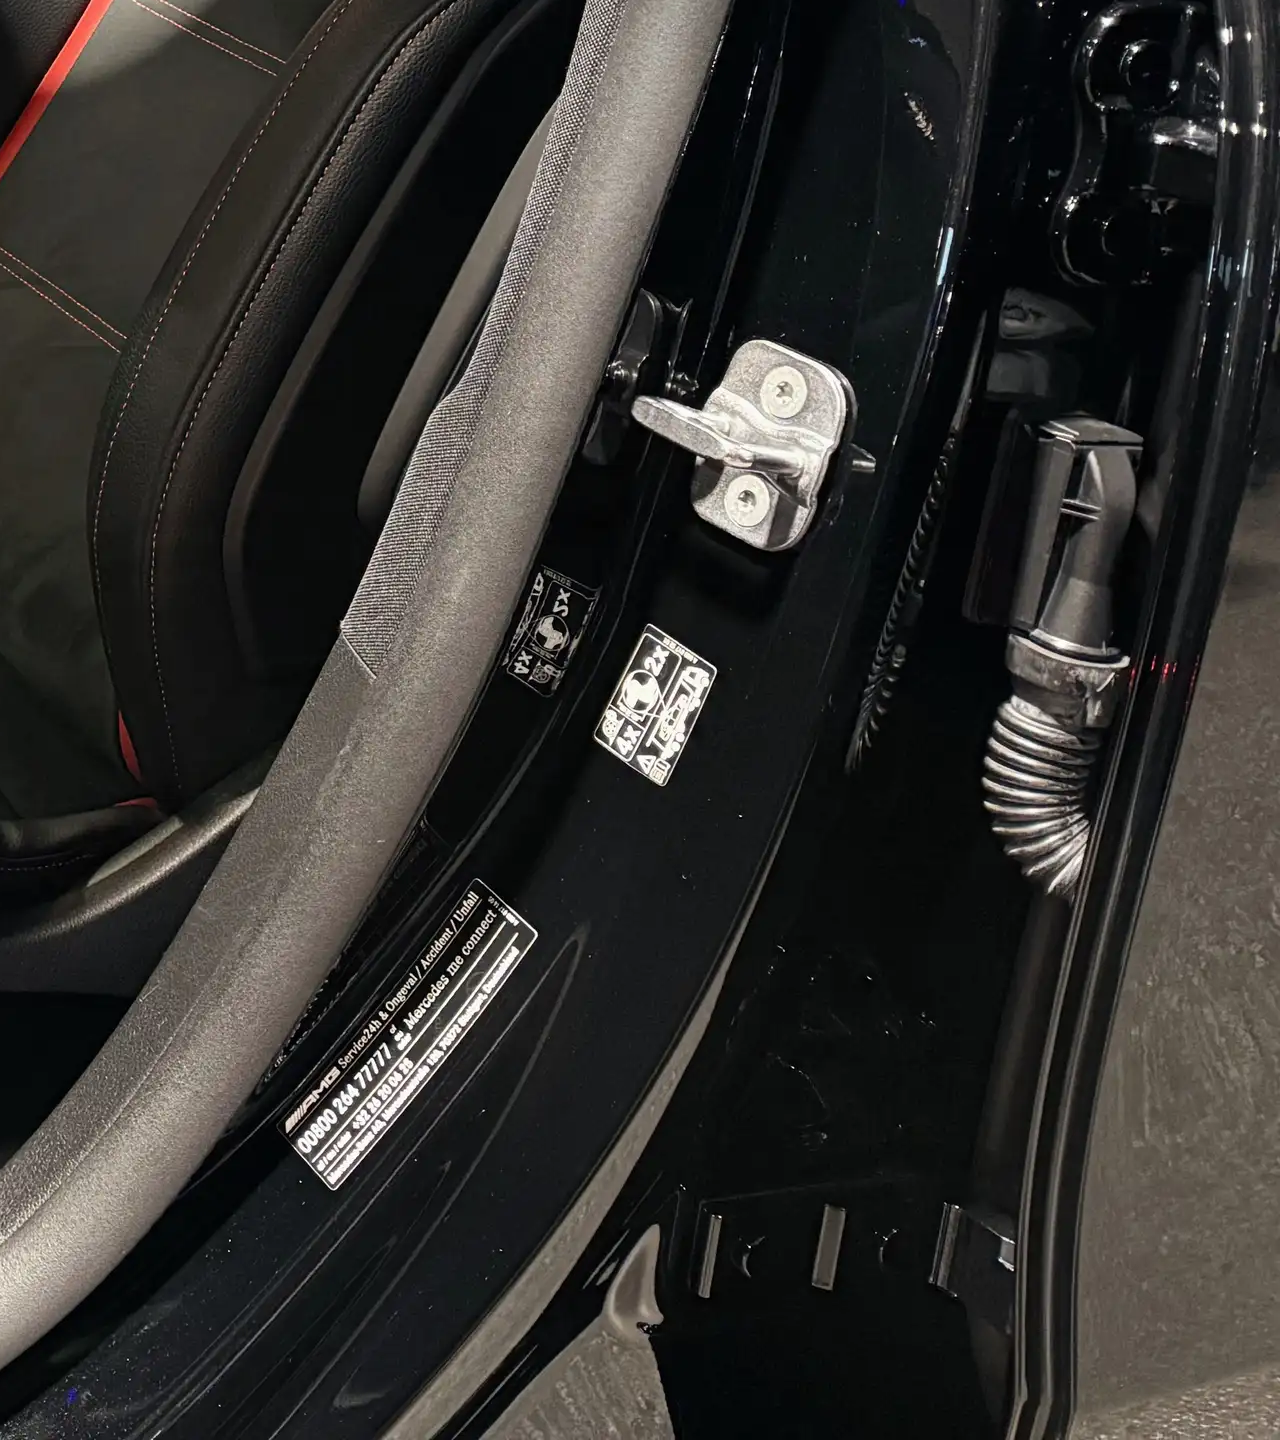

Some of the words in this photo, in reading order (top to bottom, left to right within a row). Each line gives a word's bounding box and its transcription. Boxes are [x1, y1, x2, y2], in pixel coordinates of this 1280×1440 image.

[643, 645, 670, 676] 2x
[616, 724, 641, 755] 4x
[300, 1067, 340, 1113] AMG
[338, 1020, 382, 1068] Service24h
[379, 1011, 388, 1020] &
[386, 973, 421, 1016] Ongeval
[421, 928, 453, 969] Accident
[454, 891, 479, 921] Unfall
[404, 975, 449, 1030] Mercedes
[447, 956, 463, 976] me
[462, 910, 496, 955] connect
[297, 1109, 337, 1153] 00800
[332, 1084, 360, 1115] 264
[354, 1043, 391, 1089] 77777
